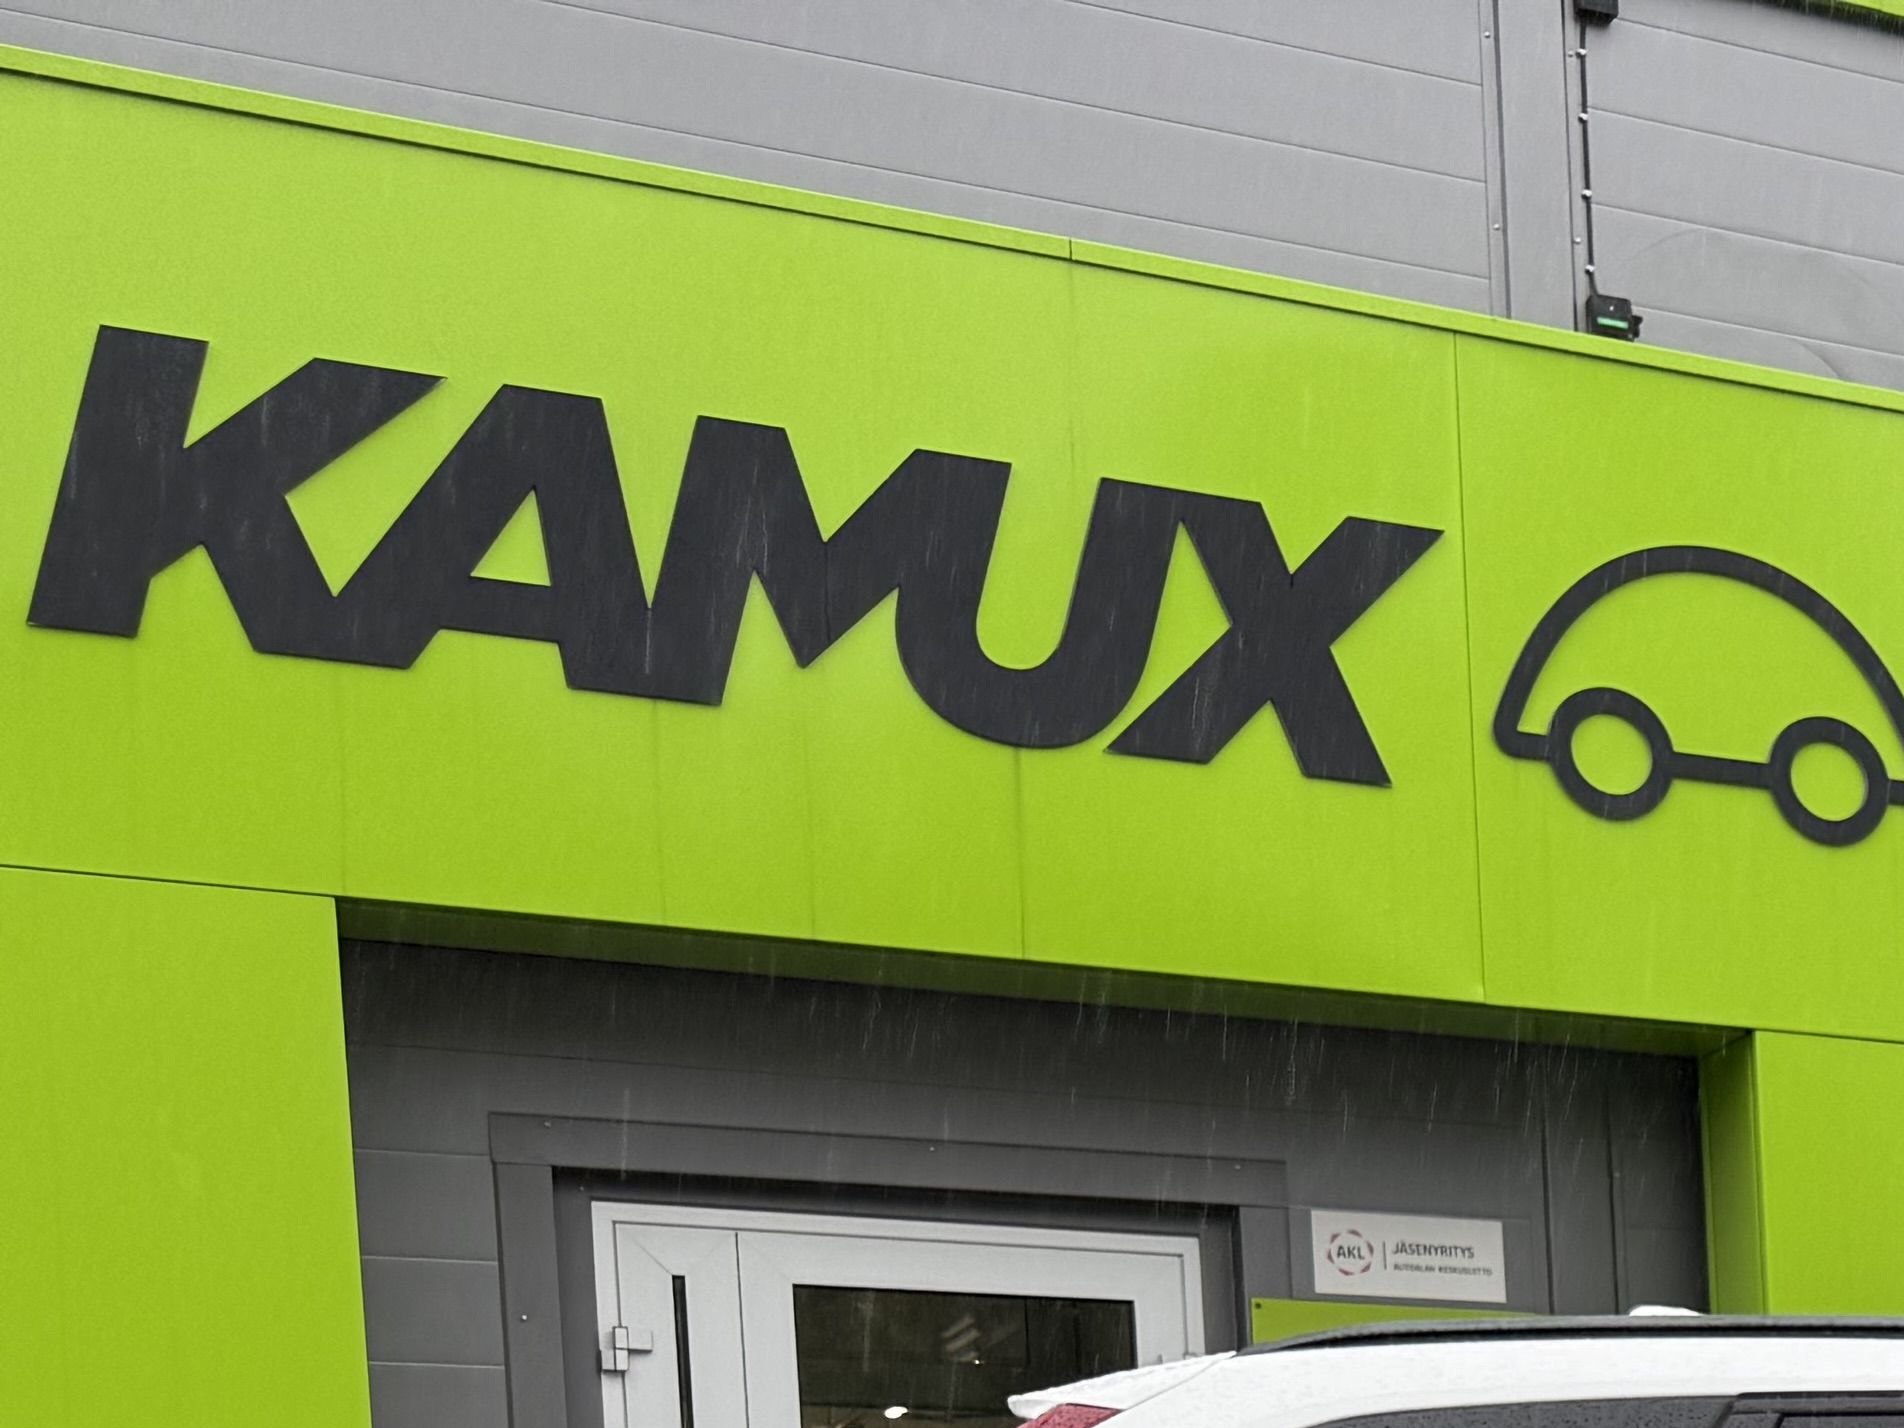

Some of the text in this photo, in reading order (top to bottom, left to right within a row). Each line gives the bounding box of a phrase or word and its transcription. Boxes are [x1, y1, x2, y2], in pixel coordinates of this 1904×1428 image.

[27, 324, 1444, 787] KAMUX
[1336, 1244, 1365, 1261] AKL
[1392, 1240, 1474, 1260] JÄSENYRITYS
